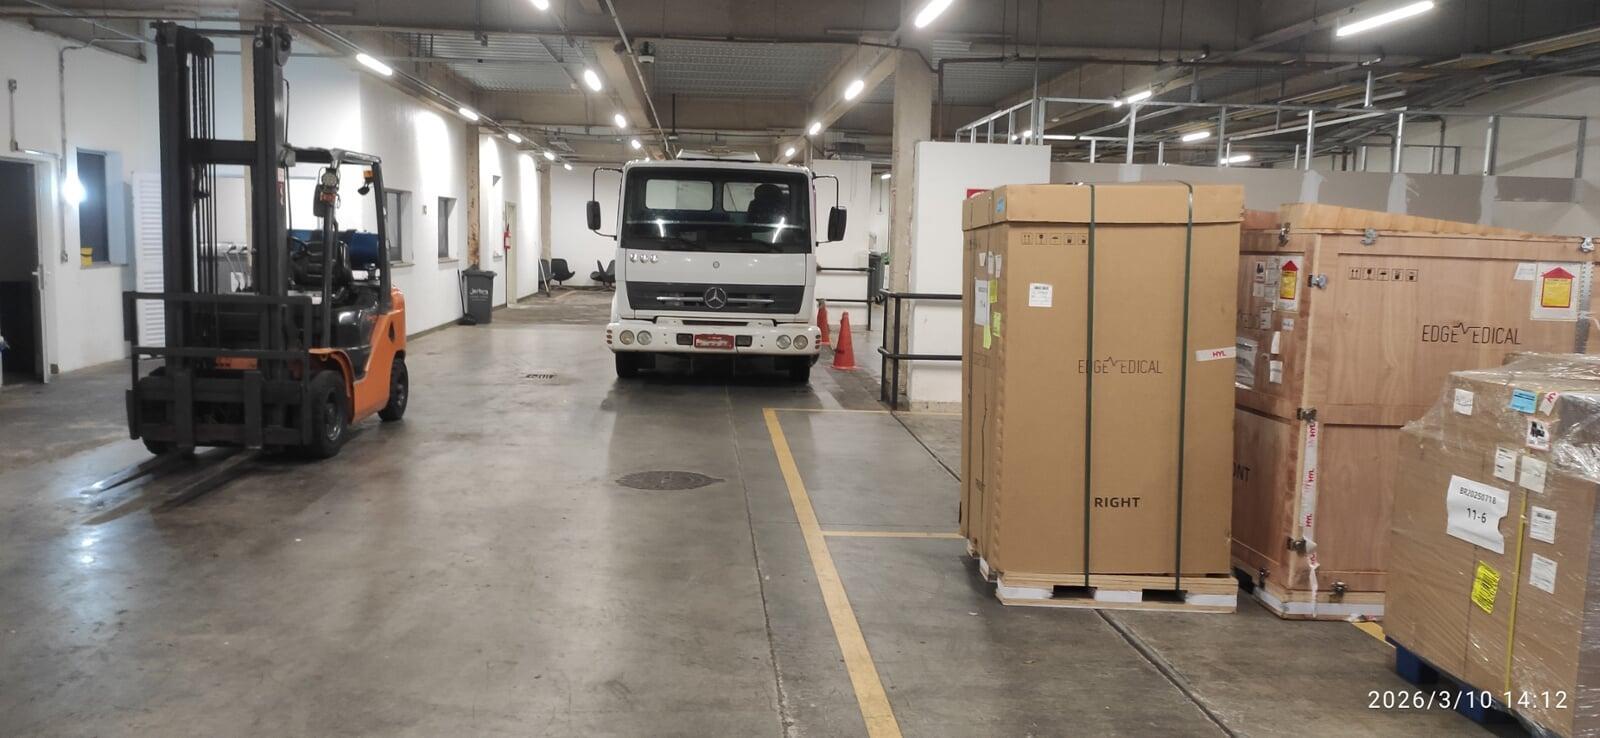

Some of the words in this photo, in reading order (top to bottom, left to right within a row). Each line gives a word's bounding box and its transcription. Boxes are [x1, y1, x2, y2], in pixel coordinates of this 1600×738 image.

[1078, 359, 1109, 374] EGE
[1094, 497, 1141, 508] RIGHT
[1466, 507, 1487, 524] 11-6
